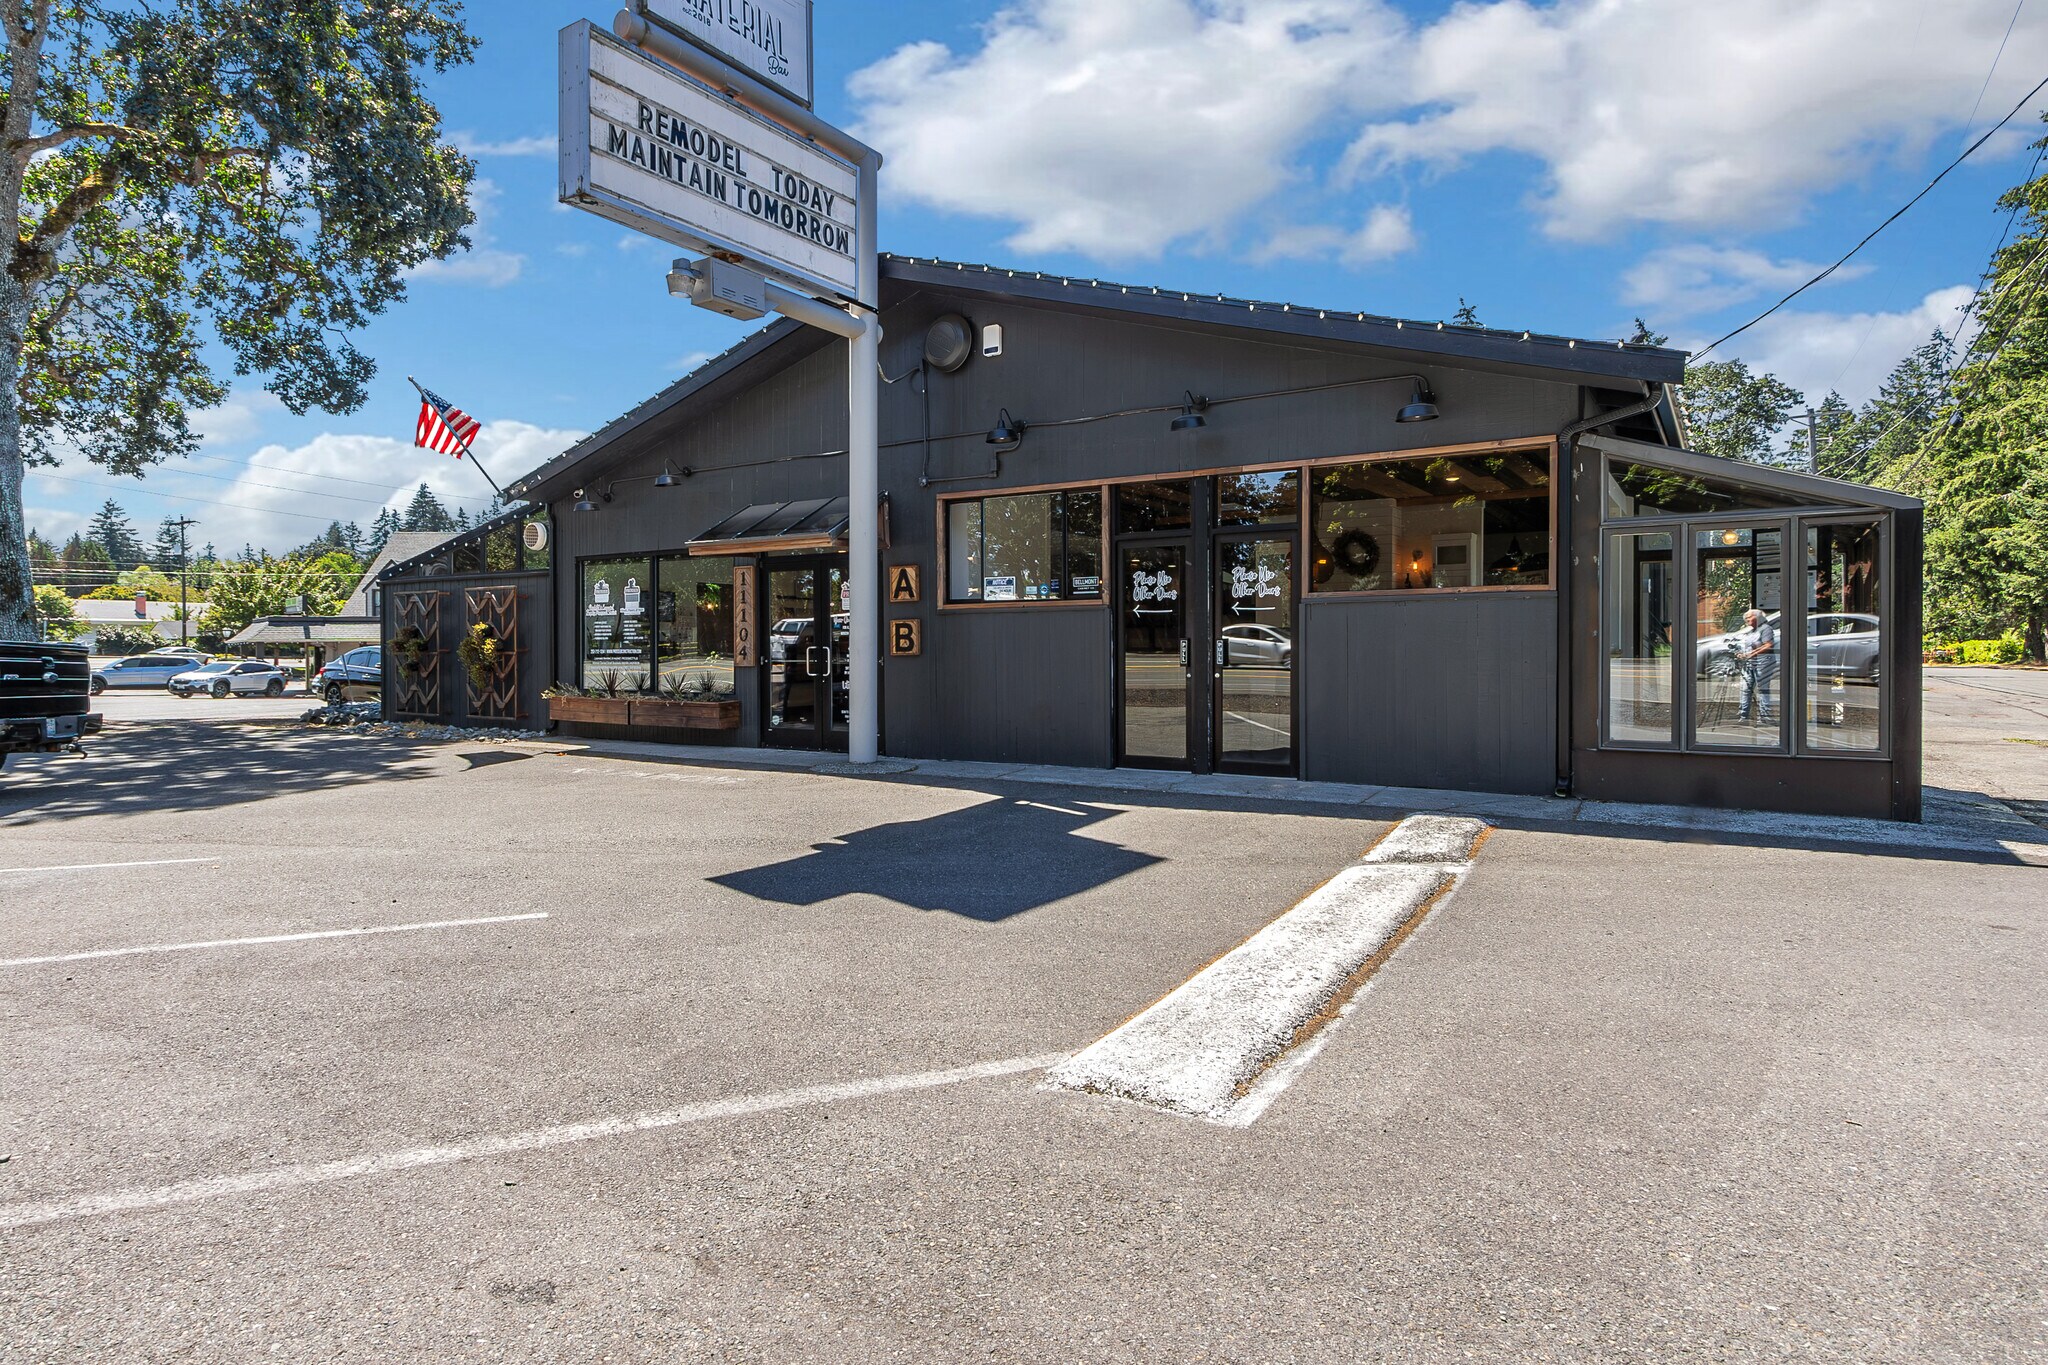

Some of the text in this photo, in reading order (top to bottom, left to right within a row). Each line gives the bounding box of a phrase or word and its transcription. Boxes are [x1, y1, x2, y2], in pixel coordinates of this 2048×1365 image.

[692, 9, 711, 27] 2018
[685, 0, 788, 64] TERIAL
[767, 55, 789, 77] Bar
[638, 100, 835, 217] REMODEL TODAY
[608, 123, 849, 254] MAINTAIN TOMORROW
[893, 568, 915, 599] A
[1132, 570, 1172, 587] Please Use
[1232, 565, 1276, 583] Please Use
[1132, 586, 1178, 601] Other Doors
[1232, 581, 1281, 598] Other Doors
[739, 571, 749, 660] 11104
[895, 622, 915, 652] B
